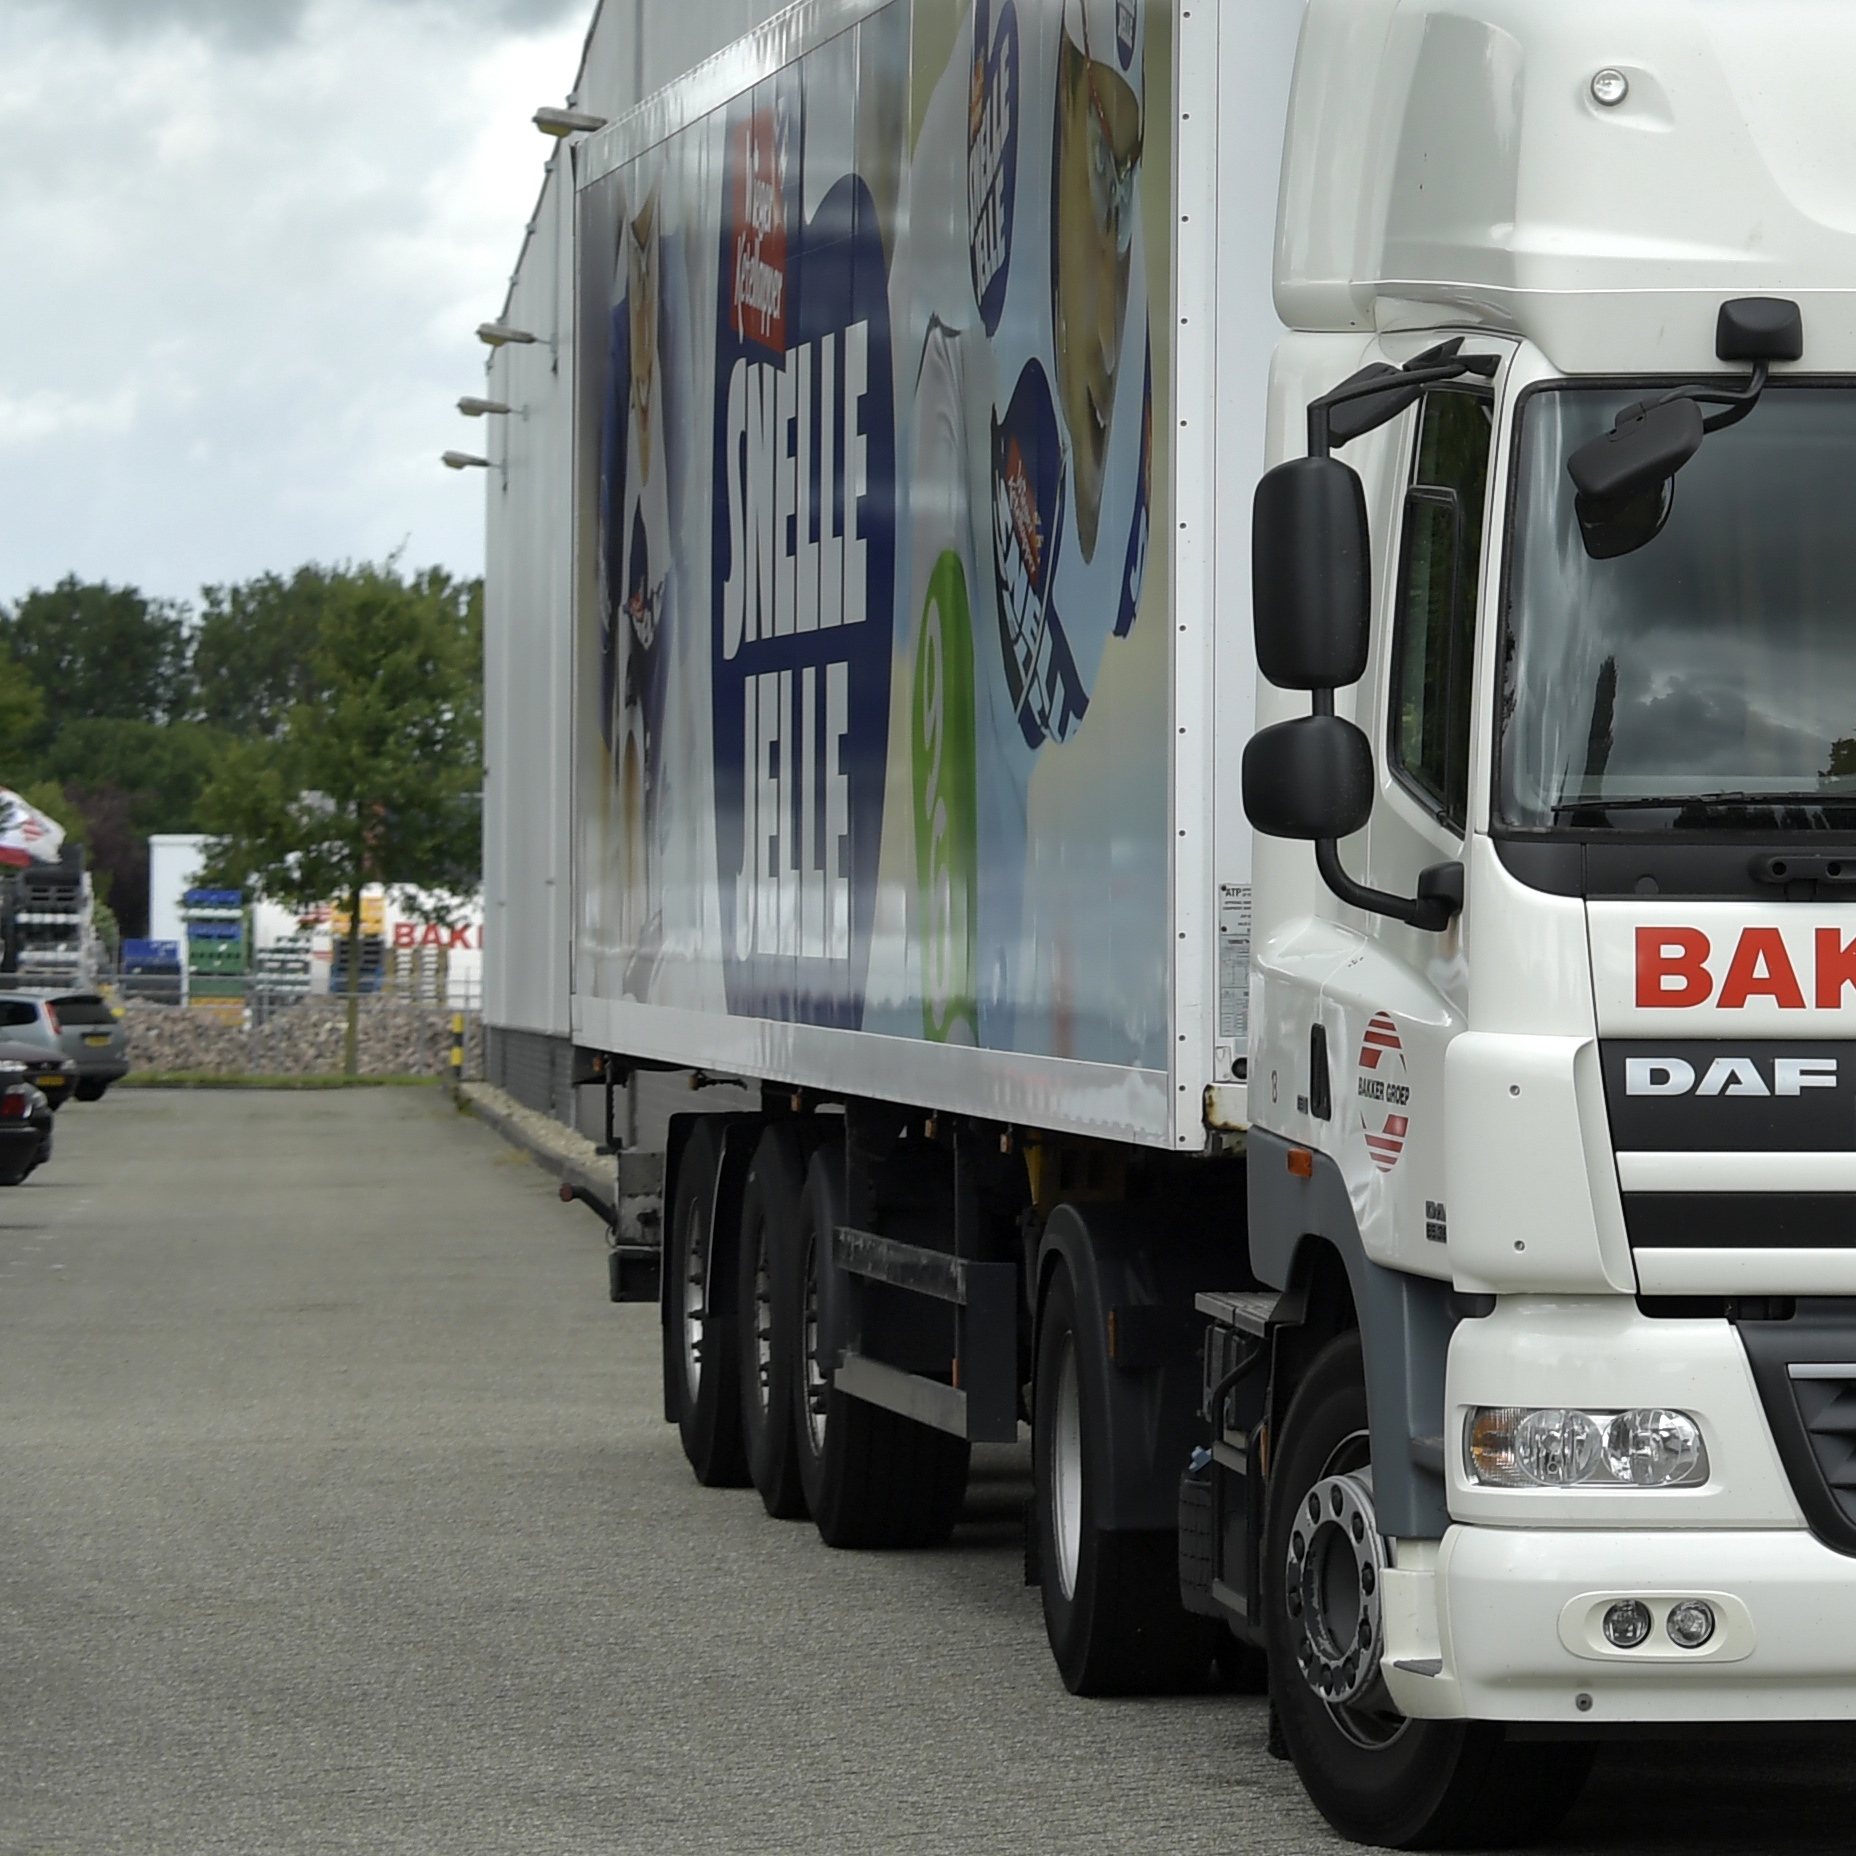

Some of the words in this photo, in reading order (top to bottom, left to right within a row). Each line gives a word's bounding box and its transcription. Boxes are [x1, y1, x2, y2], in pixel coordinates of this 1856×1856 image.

[723, 320, 867, 660] SNELLE
[736, 661, 848, 961] JELLE
[1358, 1076, 1384, 1101] BAKKER
[1386, 1083, 1410, 1106] GROEP
[1624, 1057, 1837, 1097] DAF
